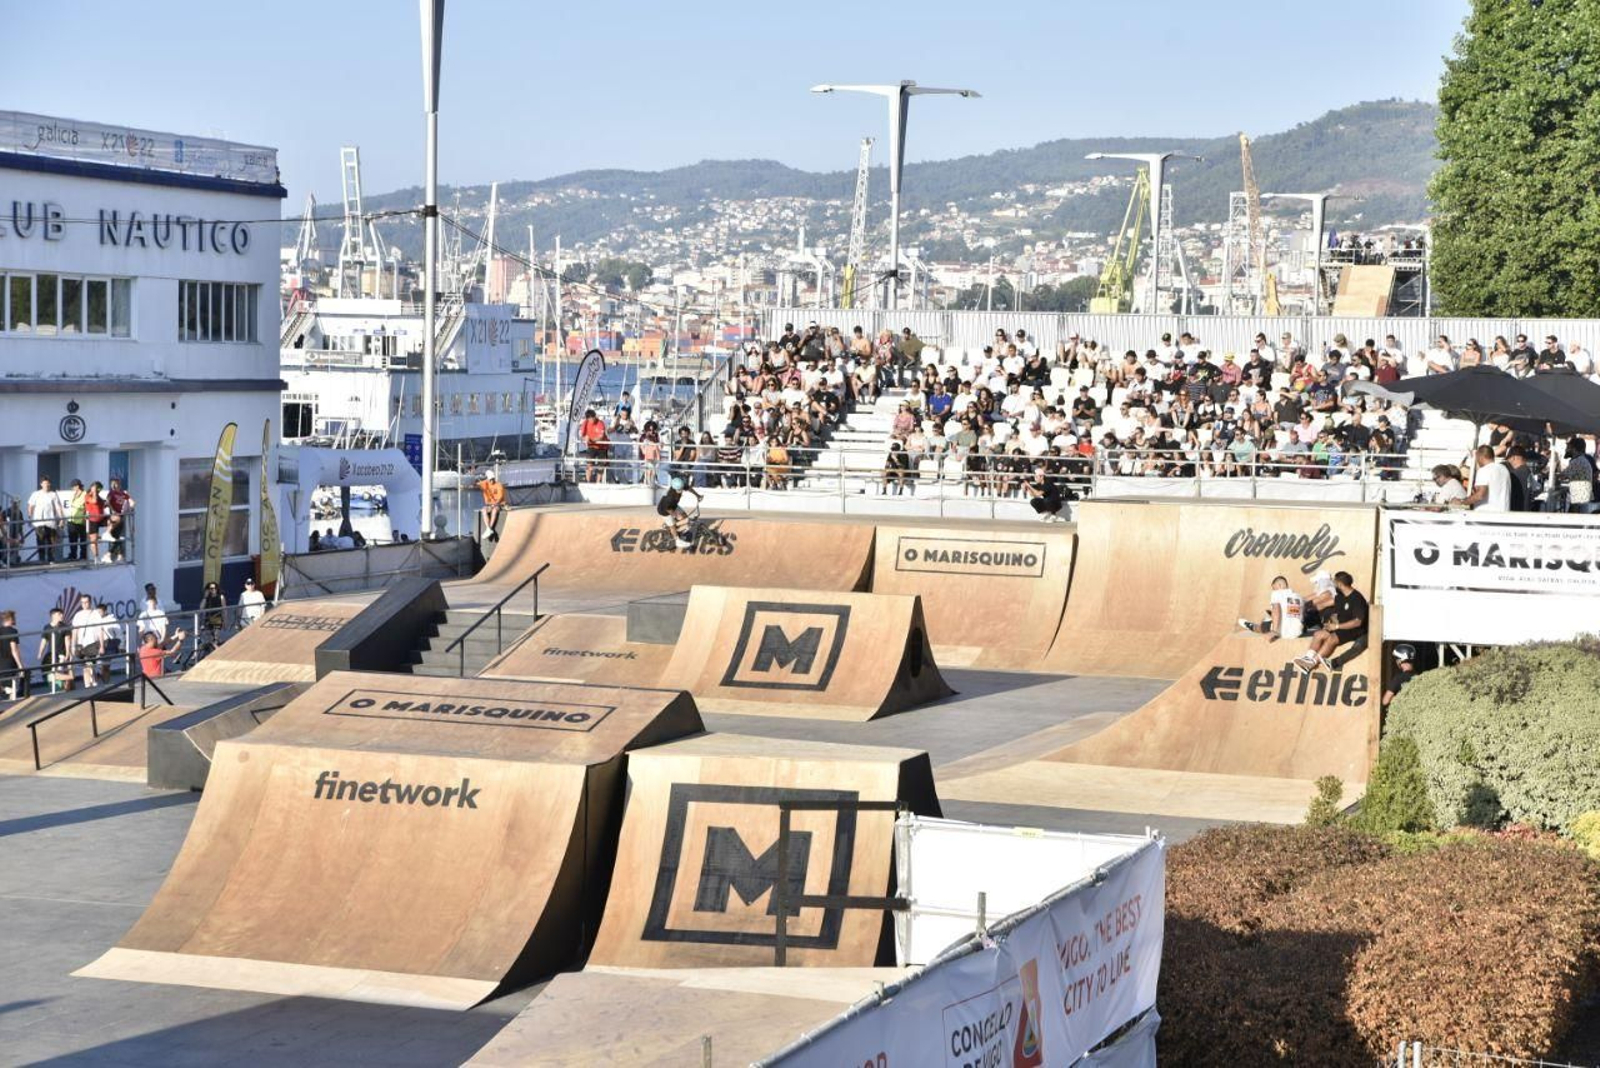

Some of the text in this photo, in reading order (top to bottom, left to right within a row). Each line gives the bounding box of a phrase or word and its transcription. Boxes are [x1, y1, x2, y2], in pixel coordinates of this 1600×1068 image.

[32, 120, 79, 147] galicia
[0, 201, 252, 255] UB NAUTICO
[904, 549, 1038, 568] O MARISQUINO
[1224, 523, 1346, 575] Cromoly
[1414, 541, 1600, 573] O MARISQ
[542, 647, 639, 661] finetwork
[751, 624, 824, 675] M
[349, 698, 591, 723] O MARISQUINO
[314, 771, 482, 809] finetwork
[693, 826, 813, 917] M
[1116, 894, 1142, 937] BEST
[1064, 973, 1095, 1015] CITY
[1096, 964, 1107, 998] TO
